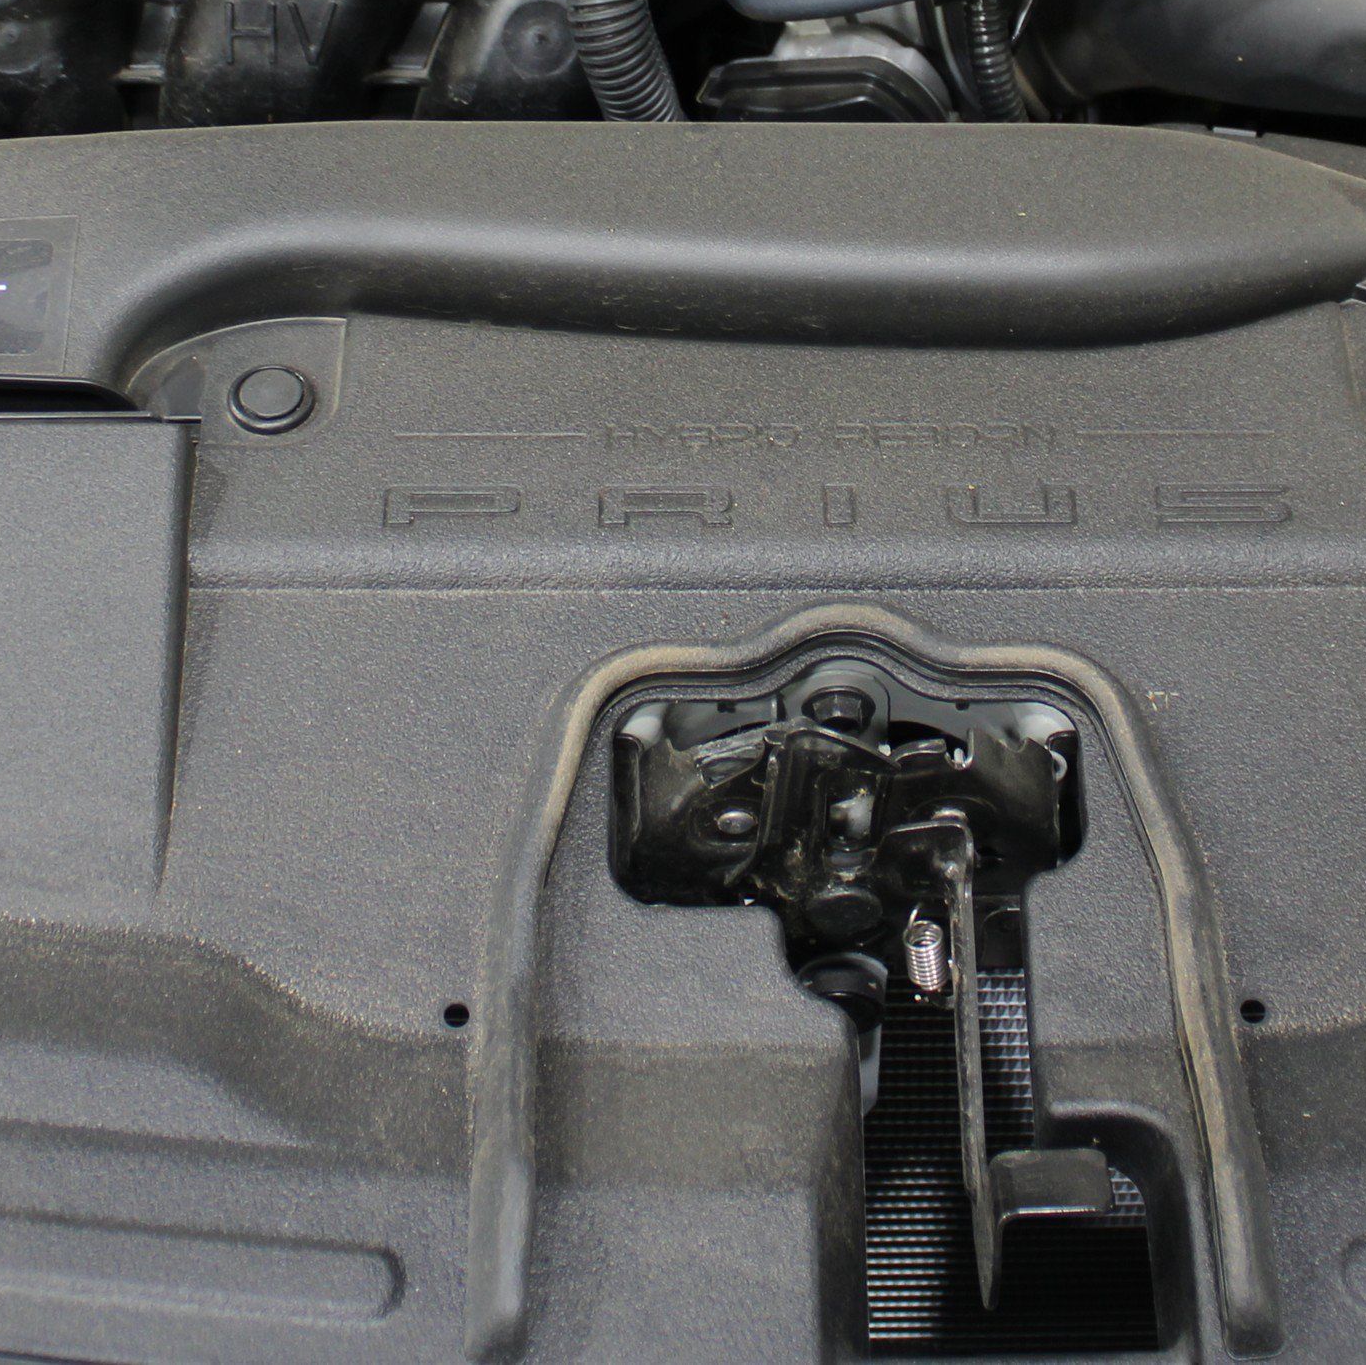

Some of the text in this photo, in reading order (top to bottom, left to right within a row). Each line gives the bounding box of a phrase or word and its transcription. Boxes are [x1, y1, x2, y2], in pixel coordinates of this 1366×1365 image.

[224, 1, 338, 65] HV
[603, 422, 1059, 450] HYBRID REBORN
[383, 482, 1295, 528] PRIUS
